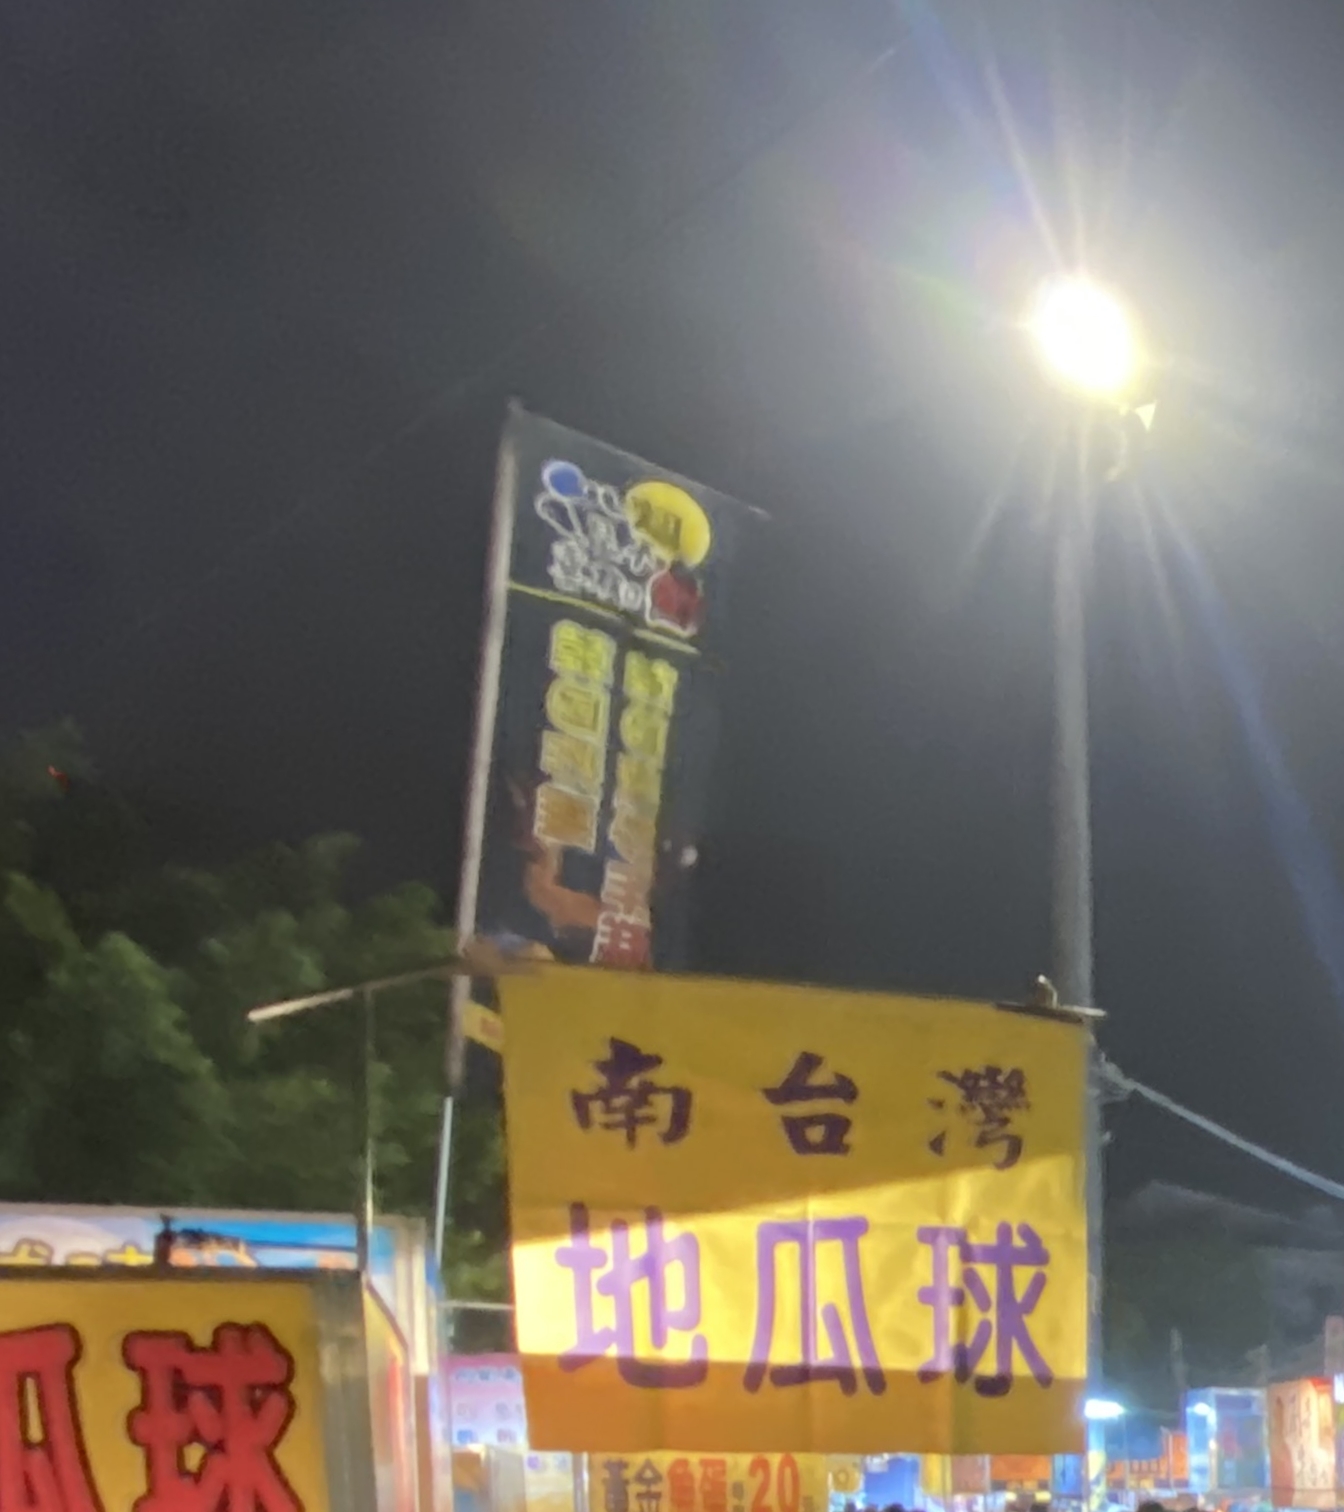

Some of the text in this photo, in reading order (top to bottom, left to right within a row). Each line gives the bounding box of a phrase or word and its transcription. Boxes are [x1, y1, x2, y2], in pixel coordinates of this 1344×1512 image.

[570, 1036, 1031, 1170] 南台灣
[555, 1201, 1053, 1396] 地瓜球
